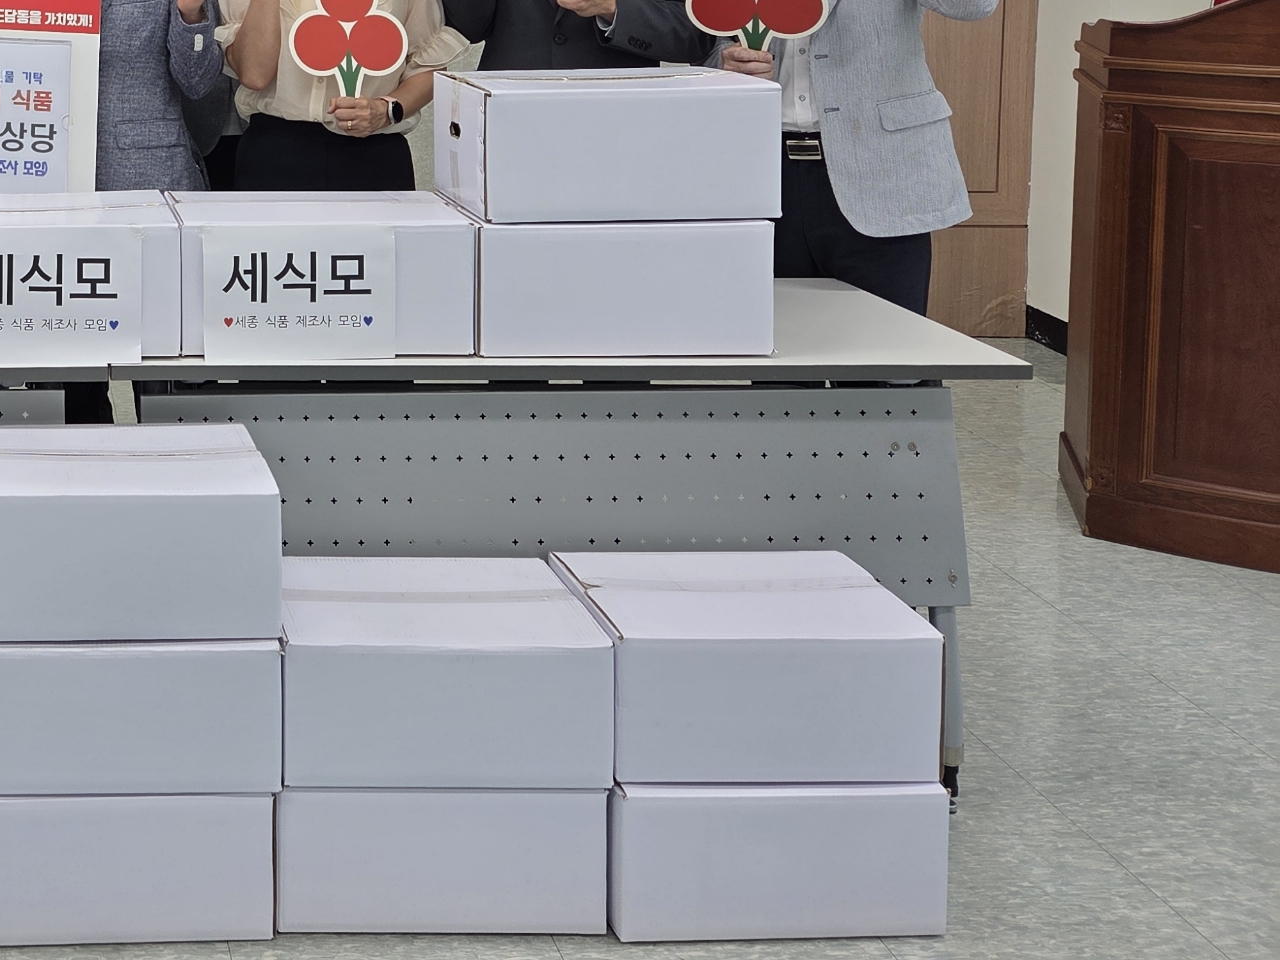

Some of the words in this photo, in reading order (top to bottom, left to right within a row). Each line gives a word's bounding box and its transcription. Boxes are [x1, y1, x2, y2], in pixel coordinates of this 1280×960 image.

[44, 12, 93, 28] 가치있게!
[22, 71, 44, 85] 기탁
[11, 89, 53, 112] 식품
[0, 121, 58, 153] 상당
[22, 160, 49, 177] 모임)
[222, 251, 372, 304] 세식모
[10, 318, 34, 332] 식품
[41, 318, 78, 332] 제조사
[83, 318, 108, 332] 모임
[234, 315, 259, 329] 세종
[265, 315, 289, 329] 식품
[295, 314, 332, 328] 제조사
[337, 314, 362, 328] 모임
